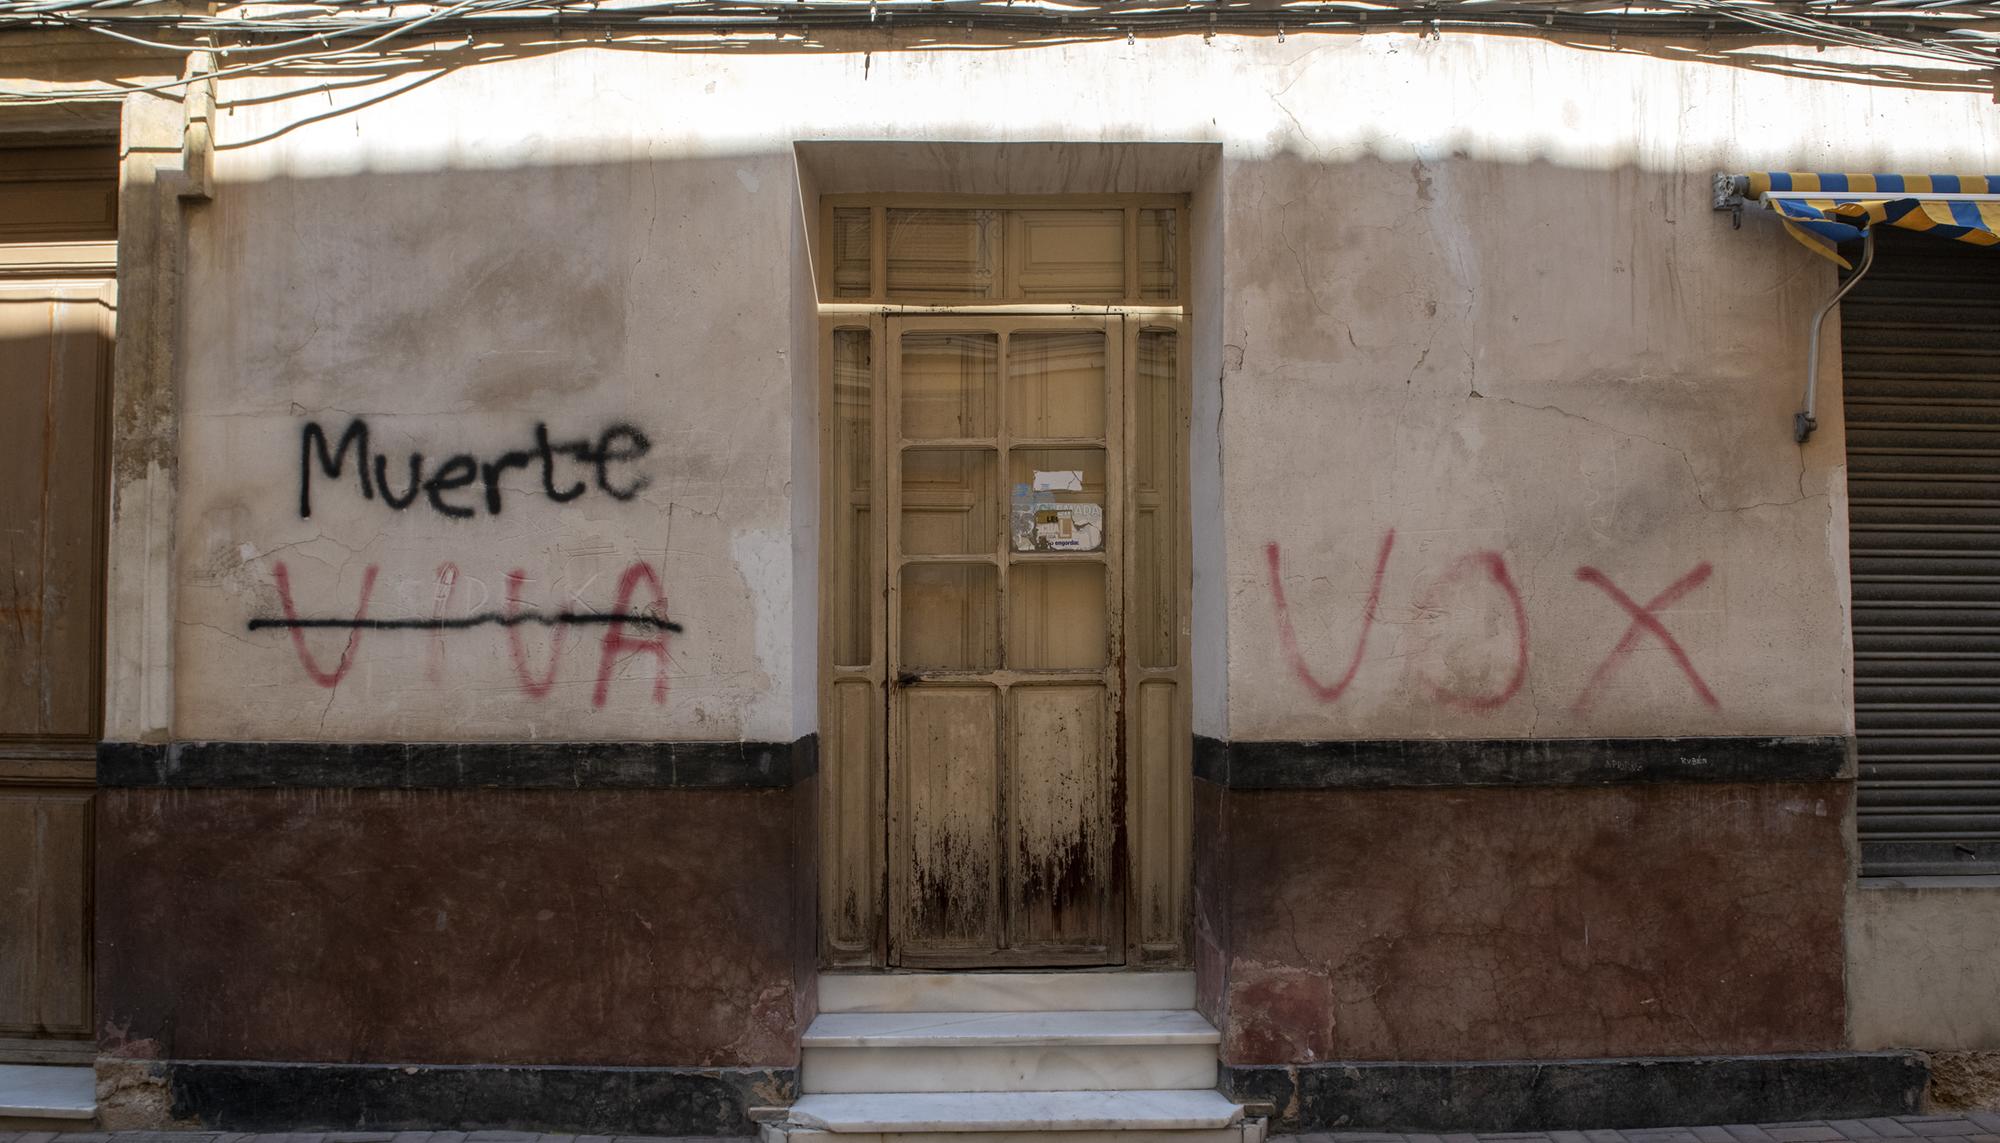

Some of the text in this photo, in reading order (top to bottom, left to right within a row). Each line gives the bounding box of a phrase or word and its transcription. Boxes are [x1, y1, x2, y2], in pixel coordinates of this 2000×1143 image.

[300, 419, 652, 518] Muerte
[274, 560, 668, 708] VIVA
[1266, 528, 1722, 718] VOX
